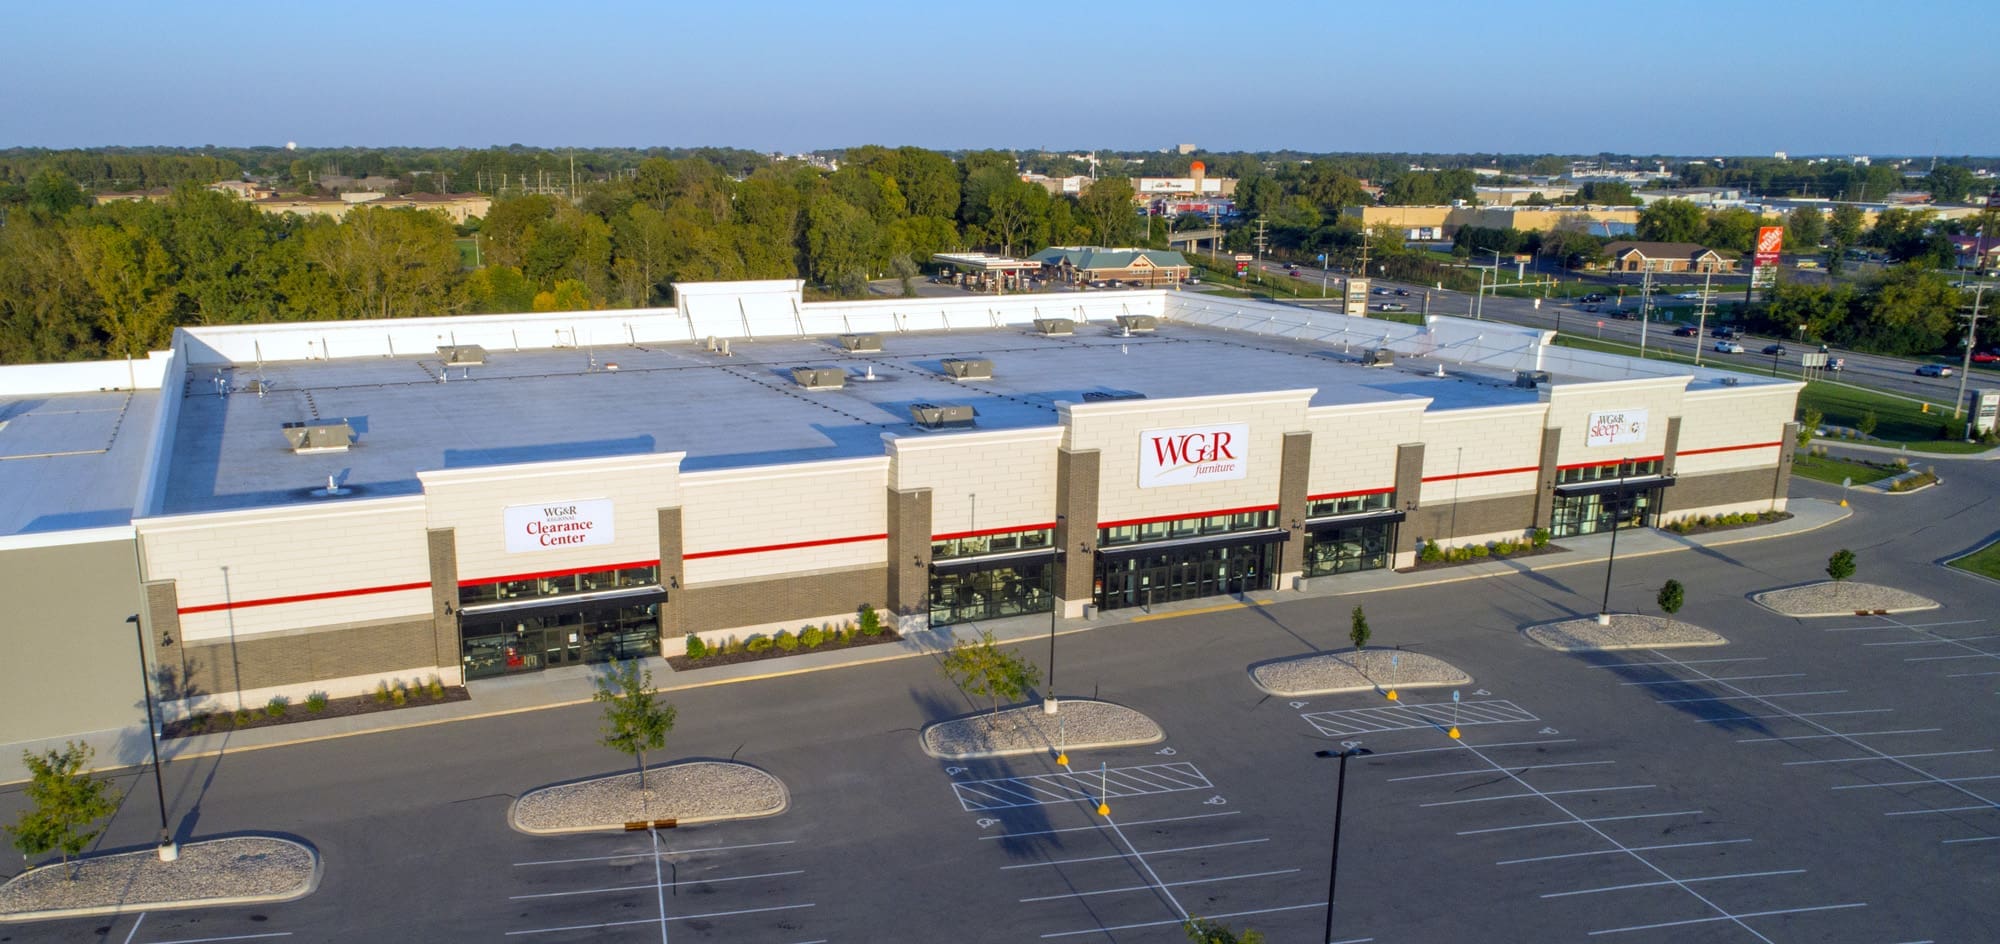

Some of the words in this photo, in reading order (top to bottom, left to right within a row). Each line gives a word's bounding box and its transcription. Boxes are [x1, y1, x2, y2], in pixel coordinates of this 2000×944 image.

[1599, 414, 1624, 424] WG&R
[1590, 420, 1619, 443] sleep
[1151, 431, 1236, 466] WG&R
[1194, 463, 1236, 478] furniture
[543, 505, 577, 517] WG&R
[526, 520, 593, 535] Clearance
[539, 533, 586, 547] Center
